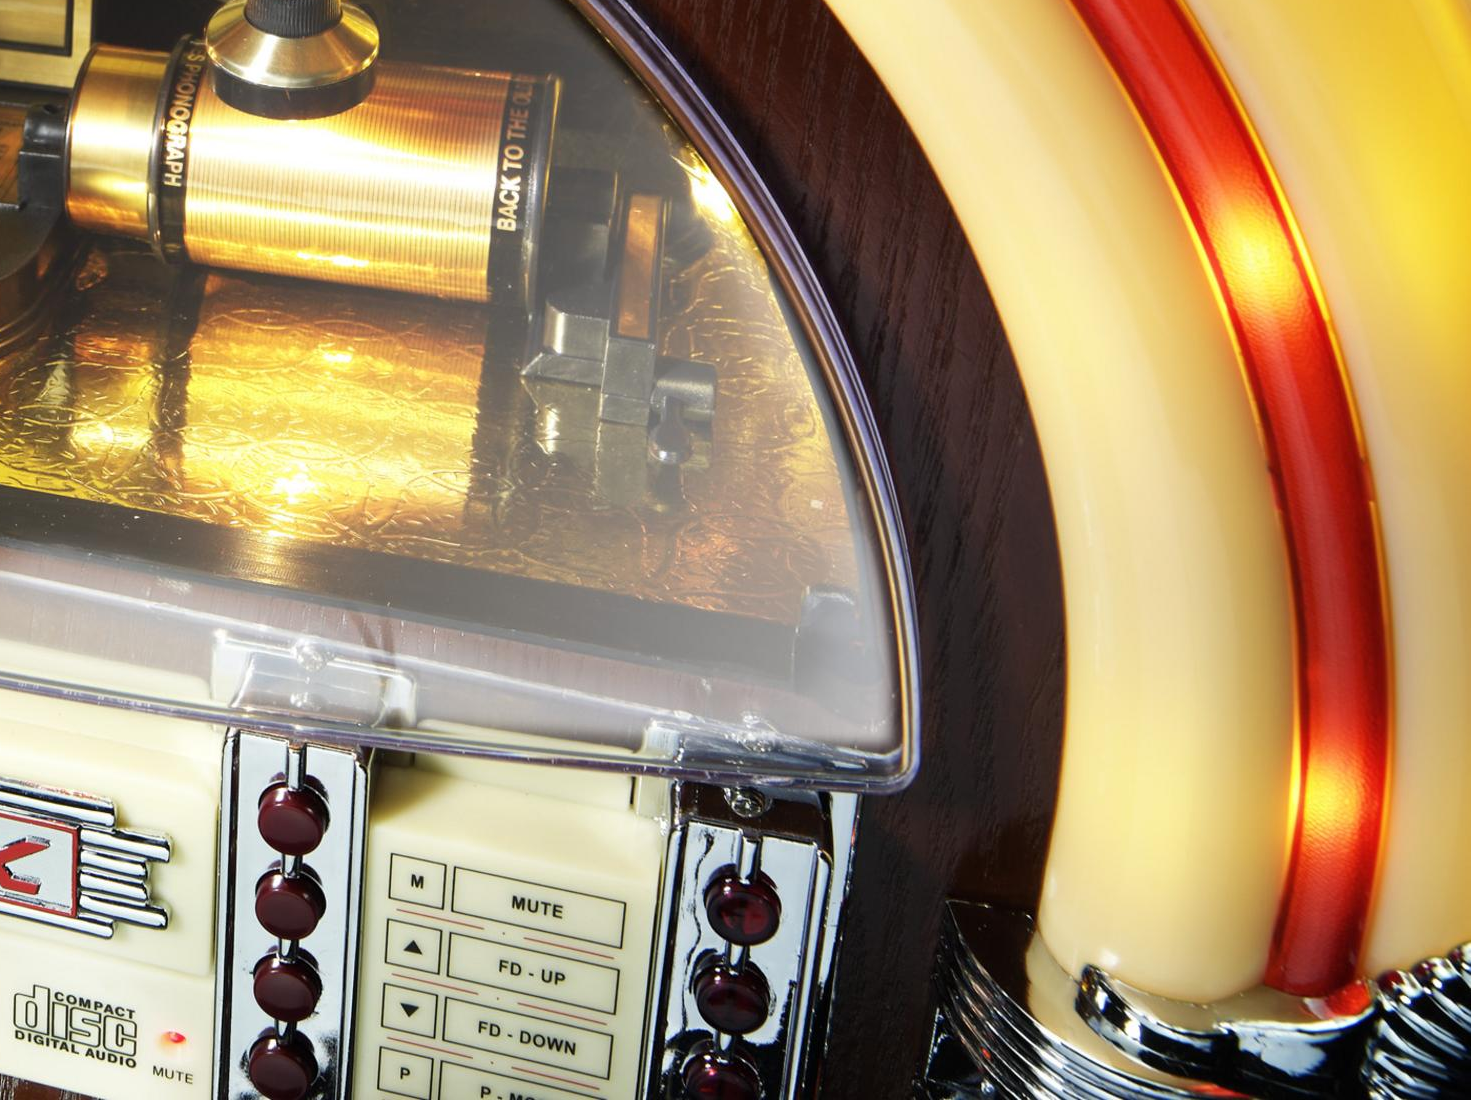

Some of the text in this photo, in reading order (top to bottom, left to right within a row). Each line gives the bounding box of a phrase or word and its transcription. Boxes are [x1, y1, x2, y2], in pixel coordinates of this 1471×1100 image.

[164, 63, 202, 188] PHONOGRAPH
[506, 107, 529, 140] THE
[503, 145, 524, 171] TO
[496, 174, 521, 232] BACK
[410, 873, 564, 920] M MUTE
[498, 958, 523, 977] FD
[541, 968, 566, 986] UP
[13, 984, 137, 1058] disc
[54, 991, 136, 1020] COMPACT
[14, 1030, 137, 1069] DIGITAL AUDIO
[478, 1020, 502, 1039] FD
[519, 1030, 577, 1056] DOWN
[152, 1065, 195, 1086] MUTE
[399, 1066, 411, 1081] P
[480, 1085, 492, 1100] P
